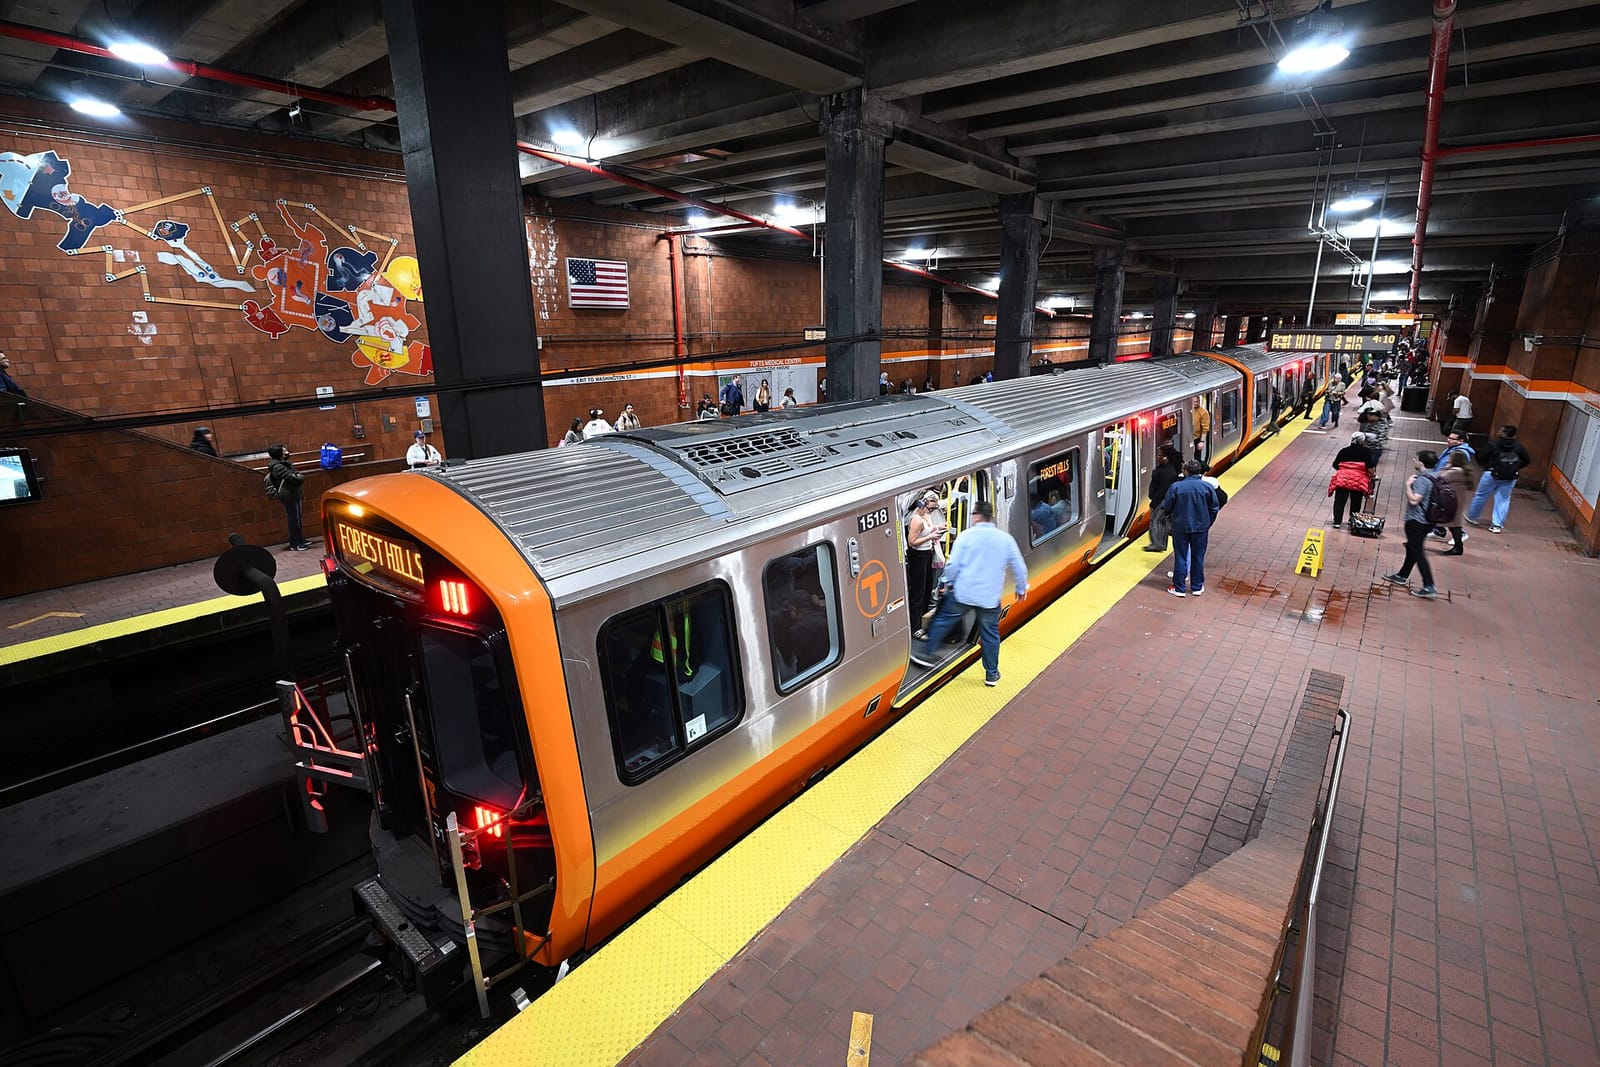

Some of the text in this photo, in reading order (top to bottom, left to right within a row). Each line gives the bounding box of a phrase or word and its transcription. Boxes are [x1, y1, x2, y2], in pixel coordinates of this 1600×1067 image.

[1372, 334, 1396, 344] 4:10
[1040, 459, 1070, 481] FOREST HILLS
[860, 508, 888, 531] 1518
[339, 523, 425, 584] FOREST HILLS
[861, 571, 883, 609] T
